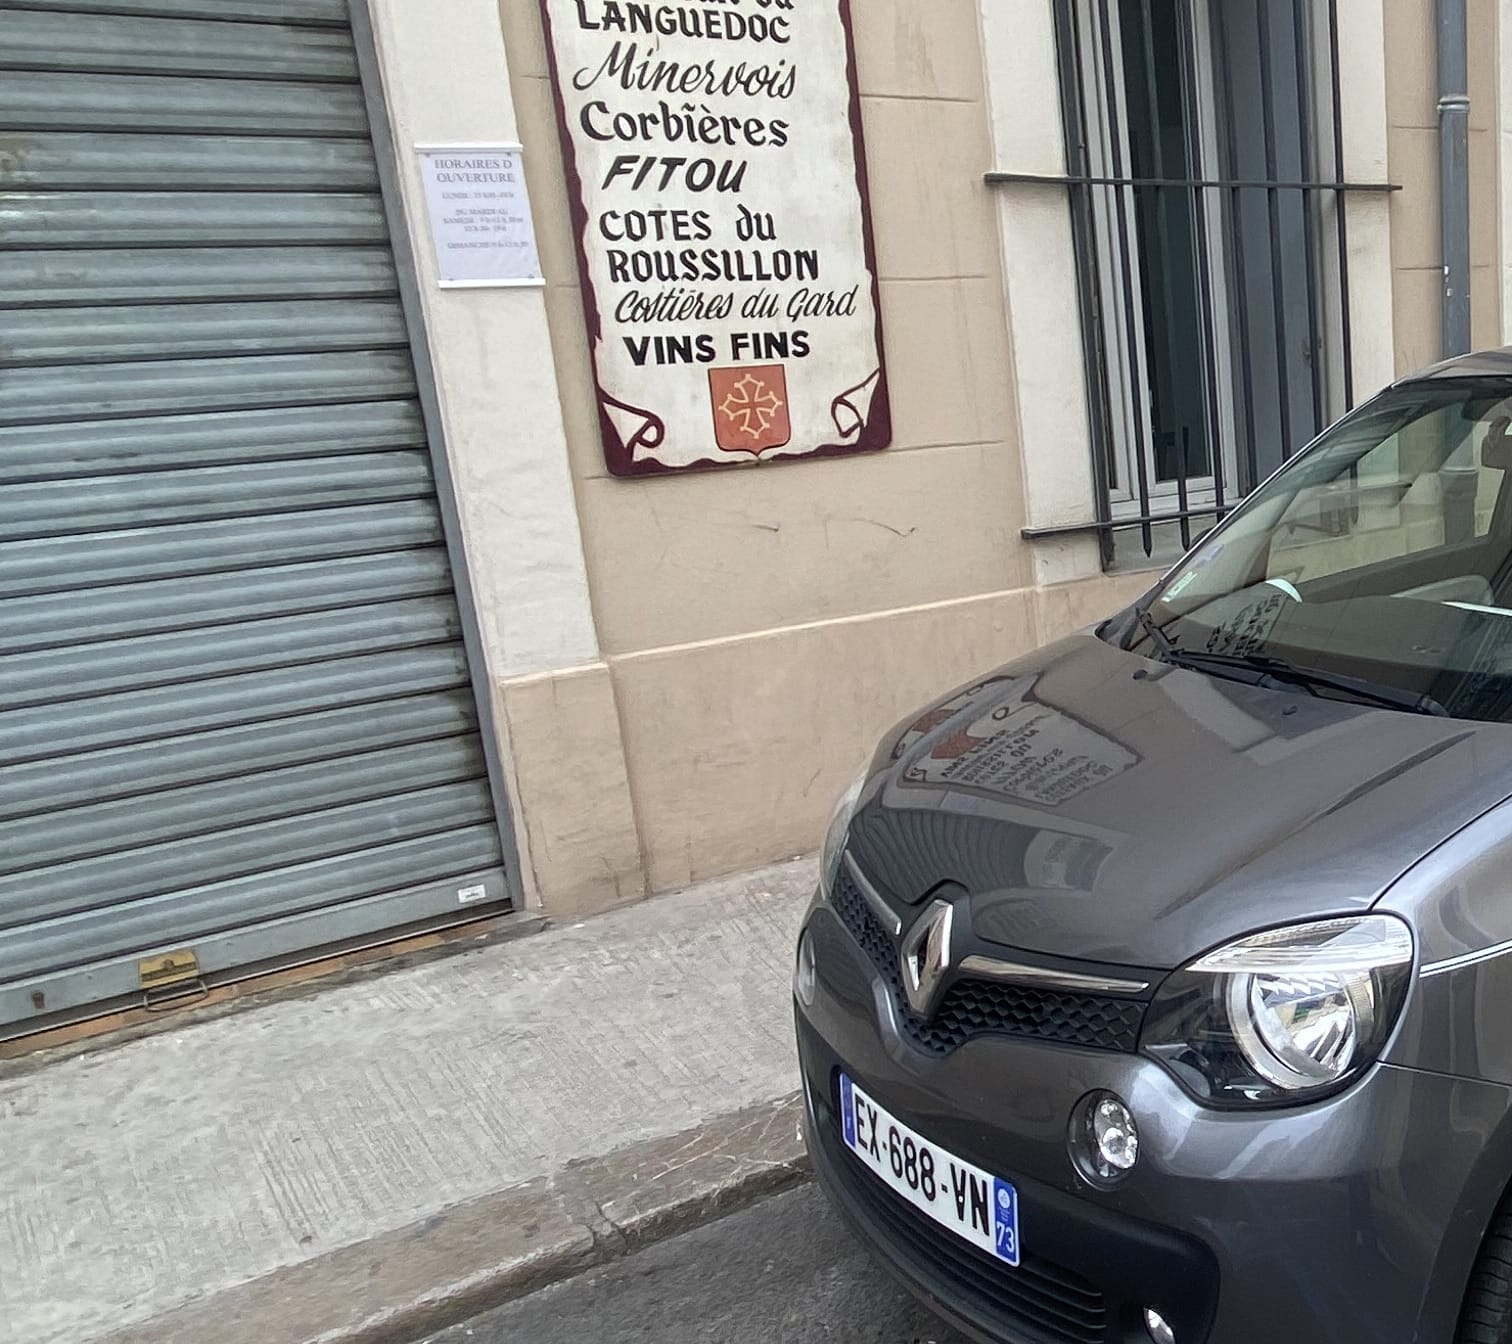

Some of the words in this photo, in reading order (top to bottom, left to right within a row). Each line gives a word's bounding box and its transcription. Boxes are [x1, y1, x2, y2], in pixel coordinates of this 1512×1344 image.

[572, 41, 796, 99] Minervois
[434, 159, 500, 169] HORAIRES
[436, 173, 515, 183] OUVERTURE
[601, 155, 747, 193] FITOU
[599, 210, 712, 241] COTES
[736, 204, 776, 241] du
[606, 249, 819, 283] ROUSSILLON
[741, 288, 779, 318] du
[786, 284, 859, 323] Gard
[622, 334, 716, 366] VINS
[730, 330, 810, 360] FINS
[855, 1093, 990, 1236] EX-688-VN
[996, 1220, 1015, 1253] 73
